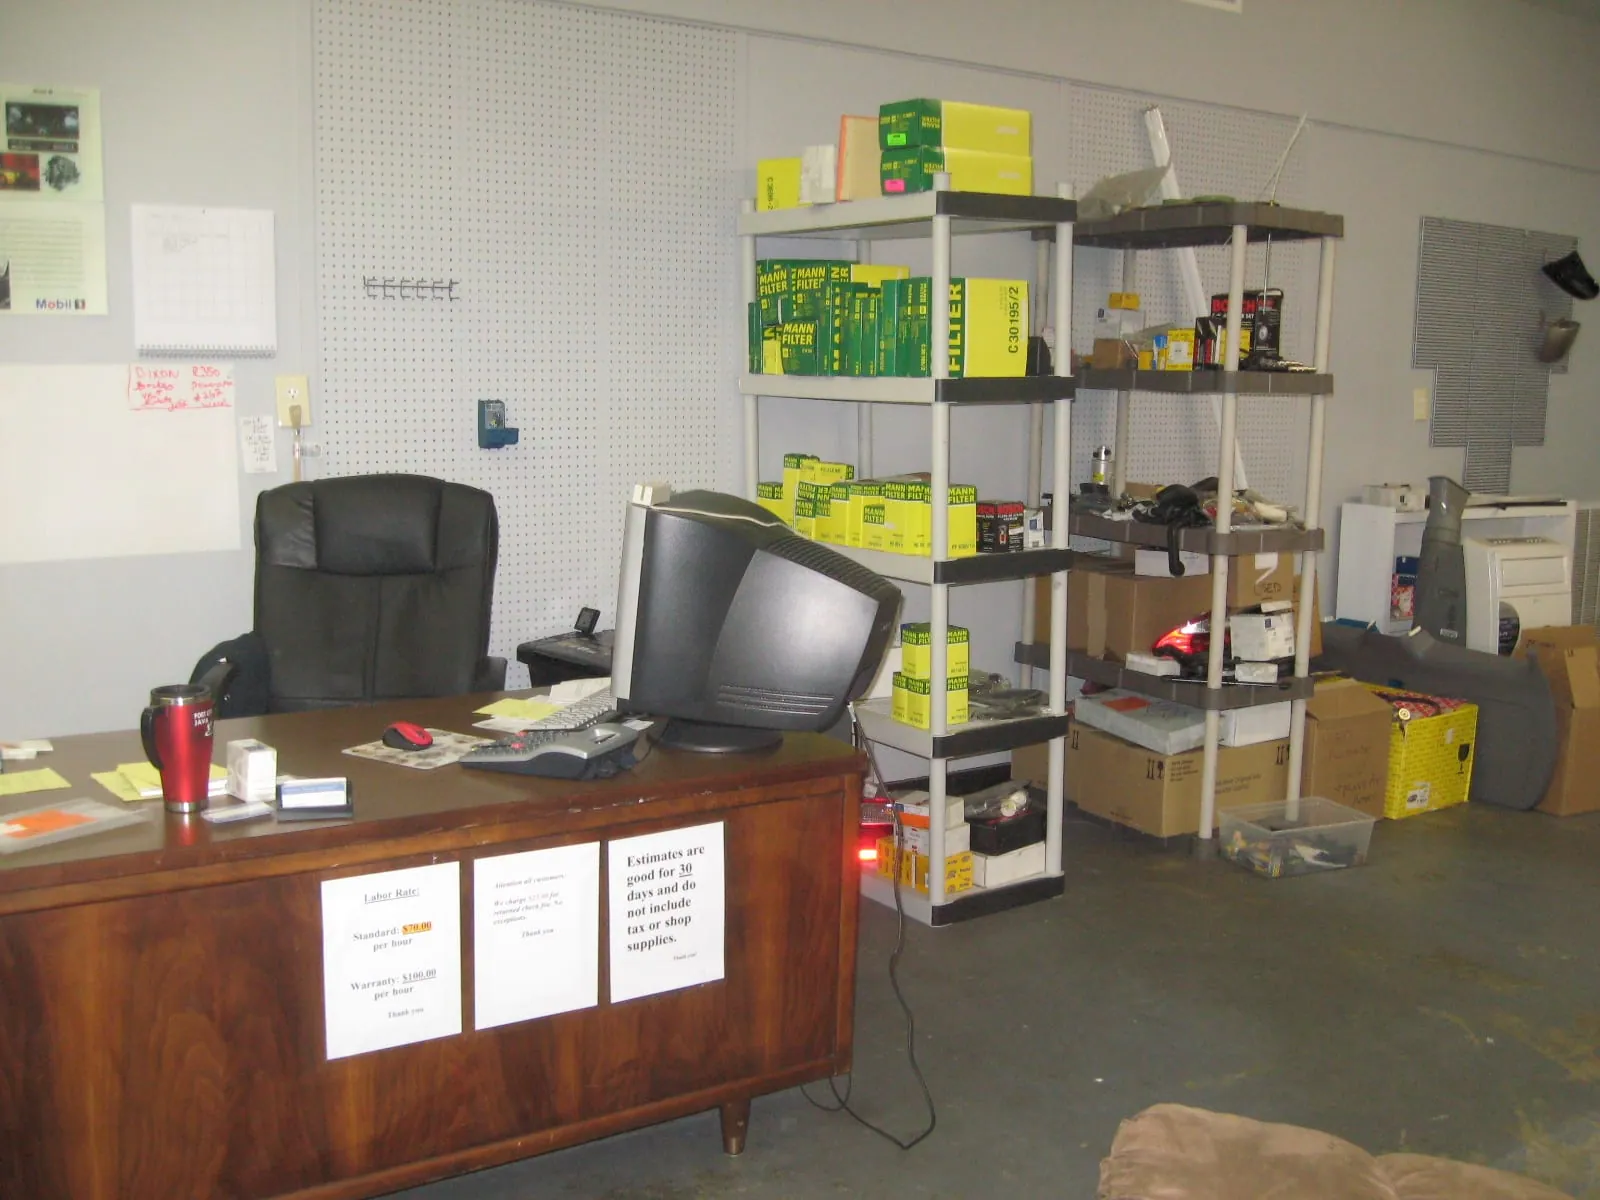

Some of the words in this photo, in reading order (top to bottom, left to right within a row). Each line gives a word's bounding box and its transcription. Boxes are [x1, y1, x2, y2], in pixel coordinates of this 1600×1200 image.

[760, 270, 787, 285] MANN
[797, 267, 826, 278] MANN
[760, 281, 787, 296] FILTER
[36, 298, 71, 310] Mobil
[783, 323, 814, 333] MANN
[949, 283, 961, 371] FILTER
[782, 334, 812, 345] FILTER
[885, 483, 906, 491] MANN
[948, 487, 975, 495] MANN
[885, 490, 906, 499] FILTER
[948, 495, 975, 503] FILTER
[864, 507, 884, 516] MANN
[864, 515, 884, 524] FILTER
[948, 628, 968, 637] MANN
[948, 636, 968, 644] FILTER
[948, 676, 968, 686] MANN
[627, 850, 684, 868] Estimates
[686, 846, 705, 857] are
[626, 869, 655, 887] good
[658, 867, 676, 880] for
[679, 863, 693, 878] 30
[364, 890, 392, 904] Labor
[627, 889, 654, 902] days
[657, 882, 679, 896] and
[682, 880, 697, 891] do
[627, 907, 646, 919] not
[649, 897, 692, 914] include
[627, 924, 645, 936] tax
[648, 920, 662, 931] or
[664, 914, 692, 928] shop
[353, 926, 400, 942] Standard:
[402, 921, 432, 935] $70.00
[522, 928, 541, 938] Thank
[372, 941, 389, 952] per
[391, 937, 413, 948] hour
[627, 934, 677, 952] supplies.
[351, 975, 400, 991] Warranty:
[402, 968, 437, 984] $100.00
[373, 990, 390, 1001] per
[392, 985, 414, 997] hour
[388, 1009, 409, 1019] Thank
